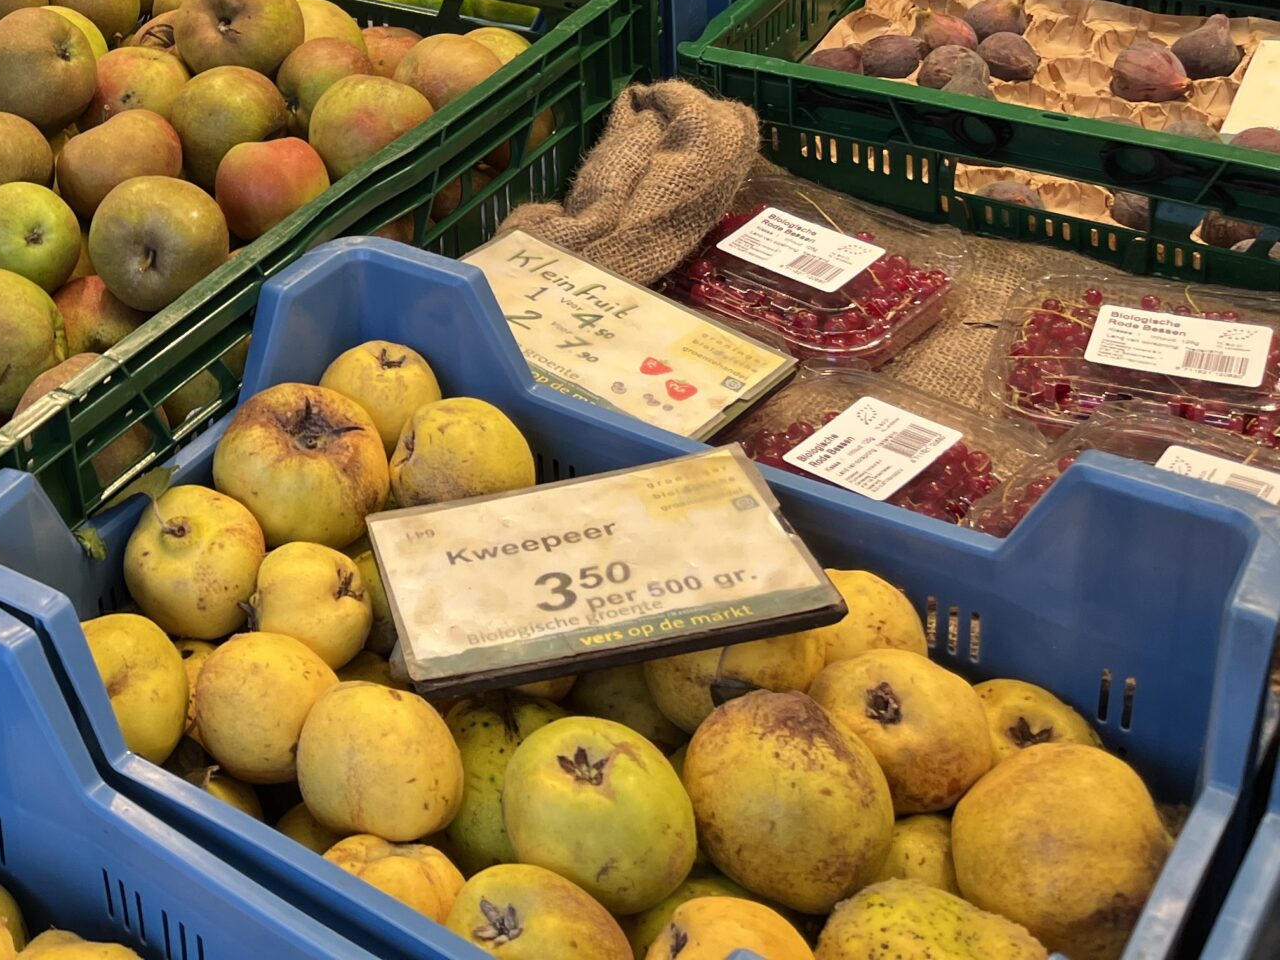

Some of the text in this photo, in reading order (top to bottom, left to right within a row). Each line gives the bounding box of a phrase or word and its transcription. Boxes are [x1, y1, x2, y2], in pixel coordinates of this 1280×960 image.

[761, 219, 784, 232] Rode
[768, 213, 817, 236] Biologische
[506, 249, 639, 319] Kleinfruit
[524, 286, 549, 301] 1
[504, 309, 543, 331] 2
[1108, 318, 1187, 338] Rode Bessen
[1110, 311, 1181, 328] Biologische
[523, 348, 580, 379] groente
[550, 382, 570, 395] de
[796, 432, 839, 463] Biologische
[807, 452, 831, 468] Rode
[446, 522, 616, 566] Kweepeer
[586, 569, 758, 613] per 500 gr.
[467, 598, 664, 646] Biologische groente
[579, 604, 754, 647] vers op de markt
